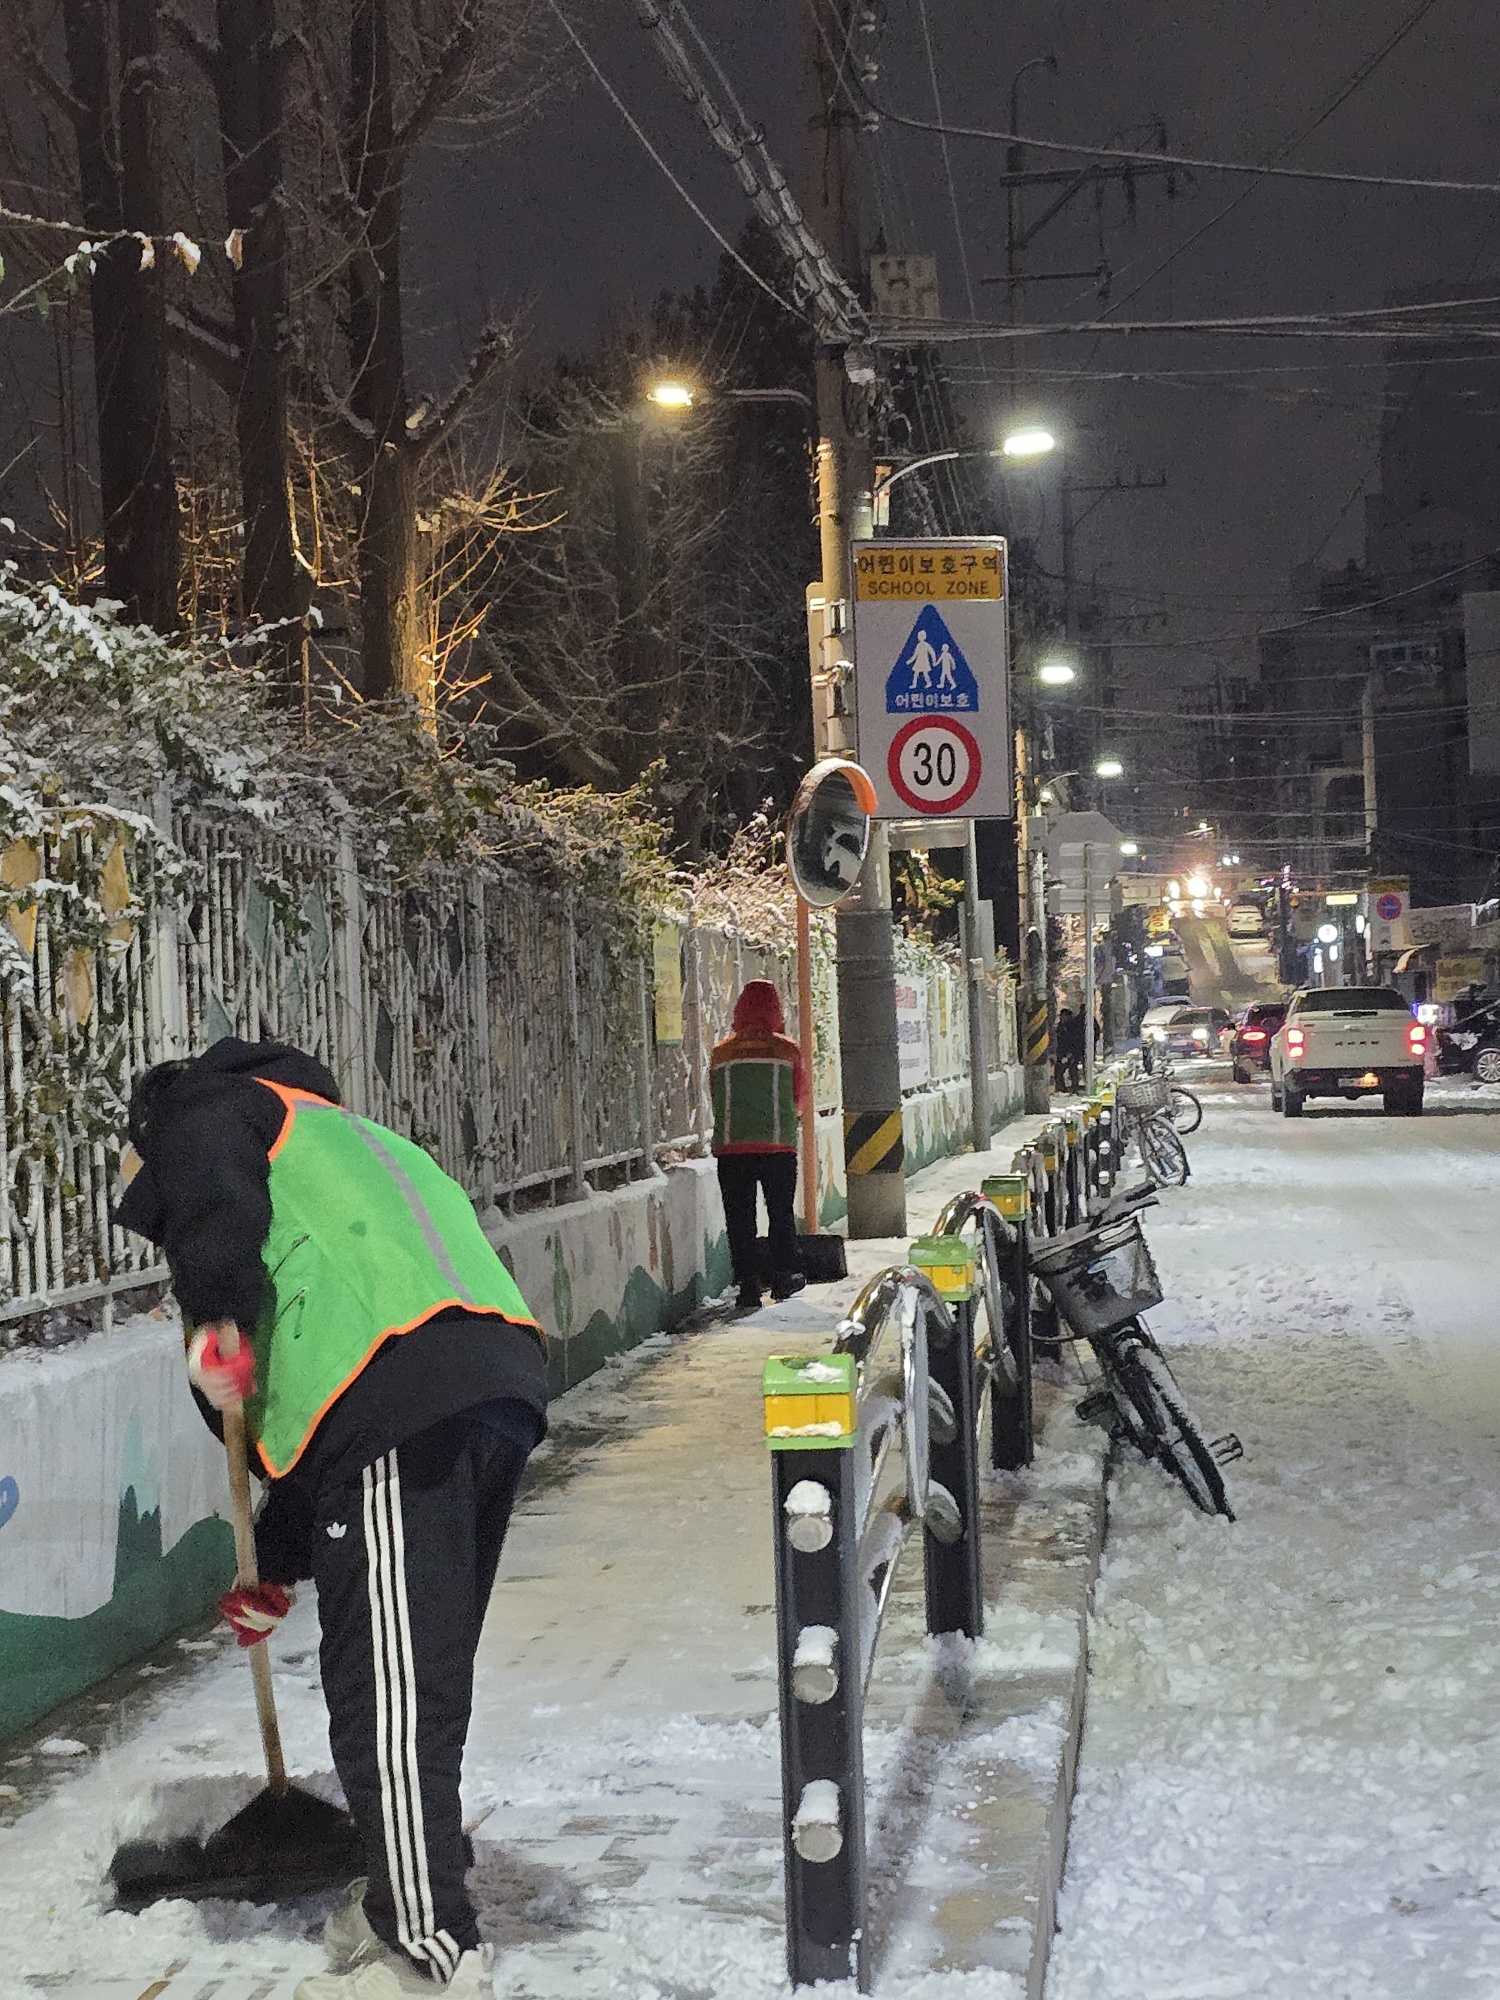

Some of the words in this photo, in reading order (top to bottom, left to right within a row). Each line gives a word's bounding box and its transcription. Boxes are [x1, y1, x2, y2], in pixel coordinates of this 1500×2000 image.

[858, 554, 998, 575] 어린이보호구역
[867, 580, 936, 596] SCHOOL
[946, 580, 990, 596] ZONE
[894, 691, 971, 709] 어린이보호
[913, 742, 956, 787] 30
